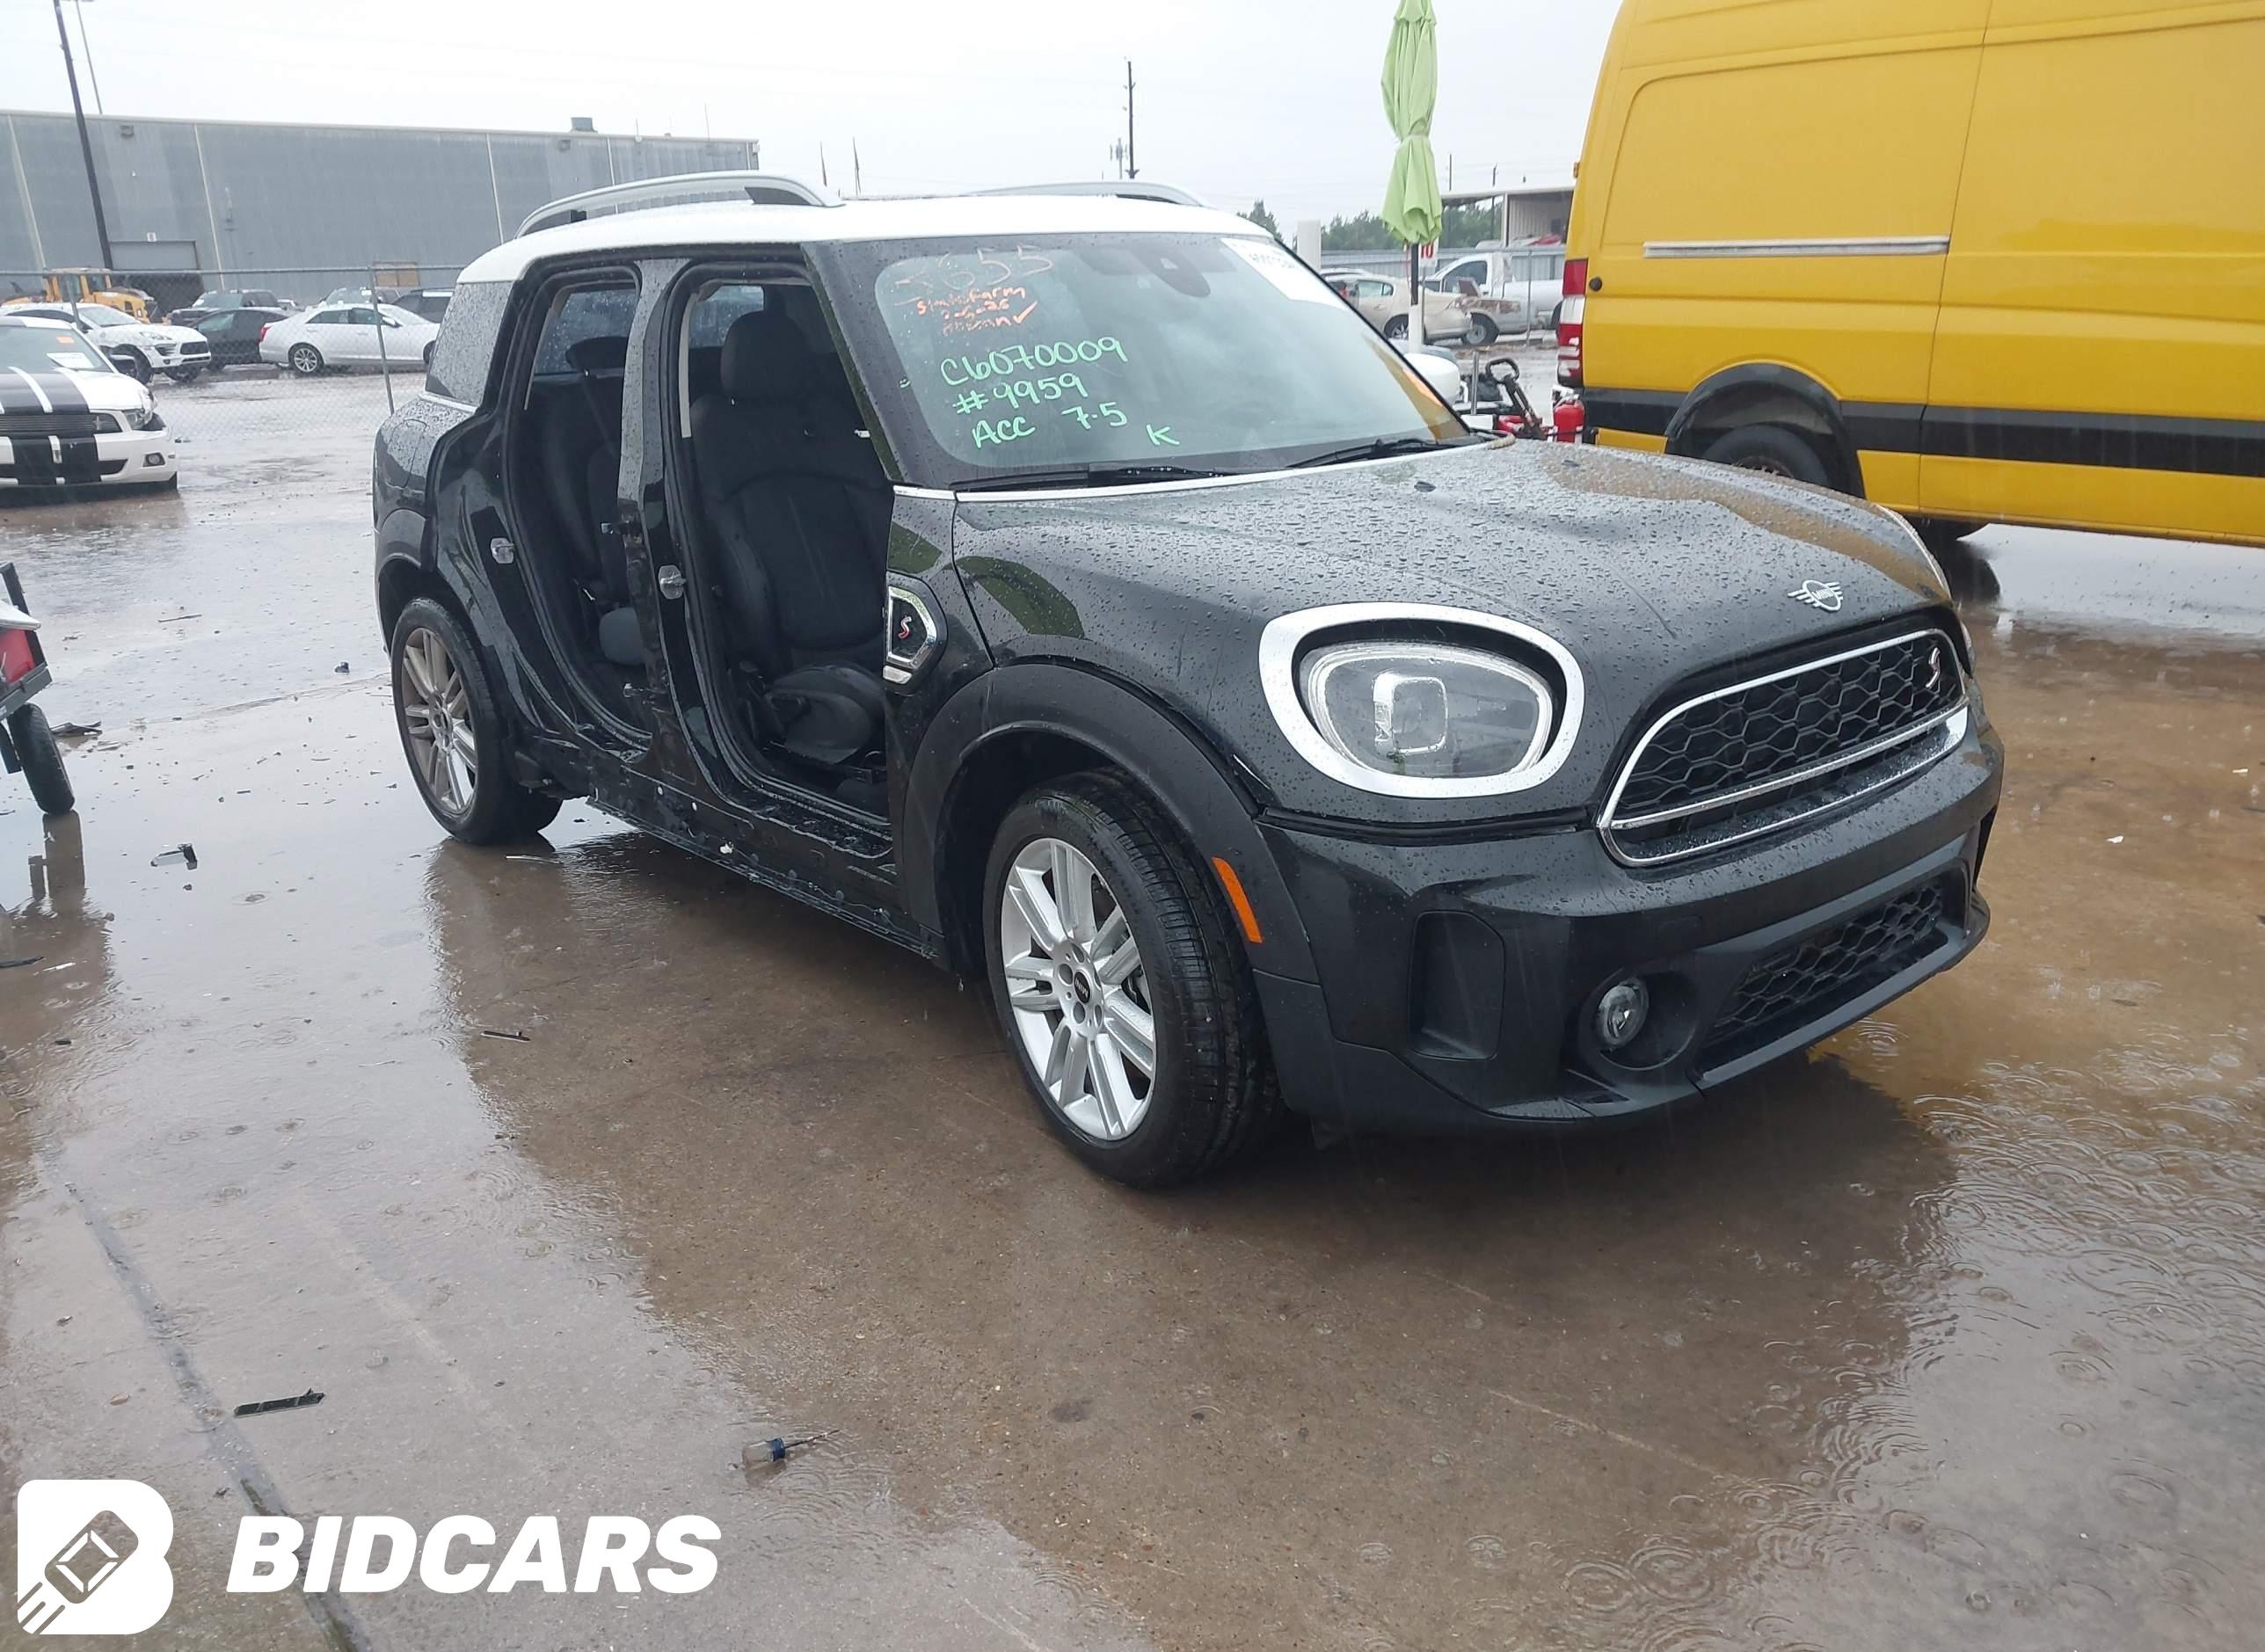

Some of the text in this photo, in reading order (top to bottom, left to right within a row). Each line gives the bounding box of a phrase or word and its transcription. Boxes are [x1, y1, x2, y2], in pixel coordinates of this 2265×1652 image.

[940, 337, 1128, 385] C6070009
[952, 373, 1088, 414] #9959
[971, 417, 1036, 448] ACC
[1146, 424, 1181, 446] K
